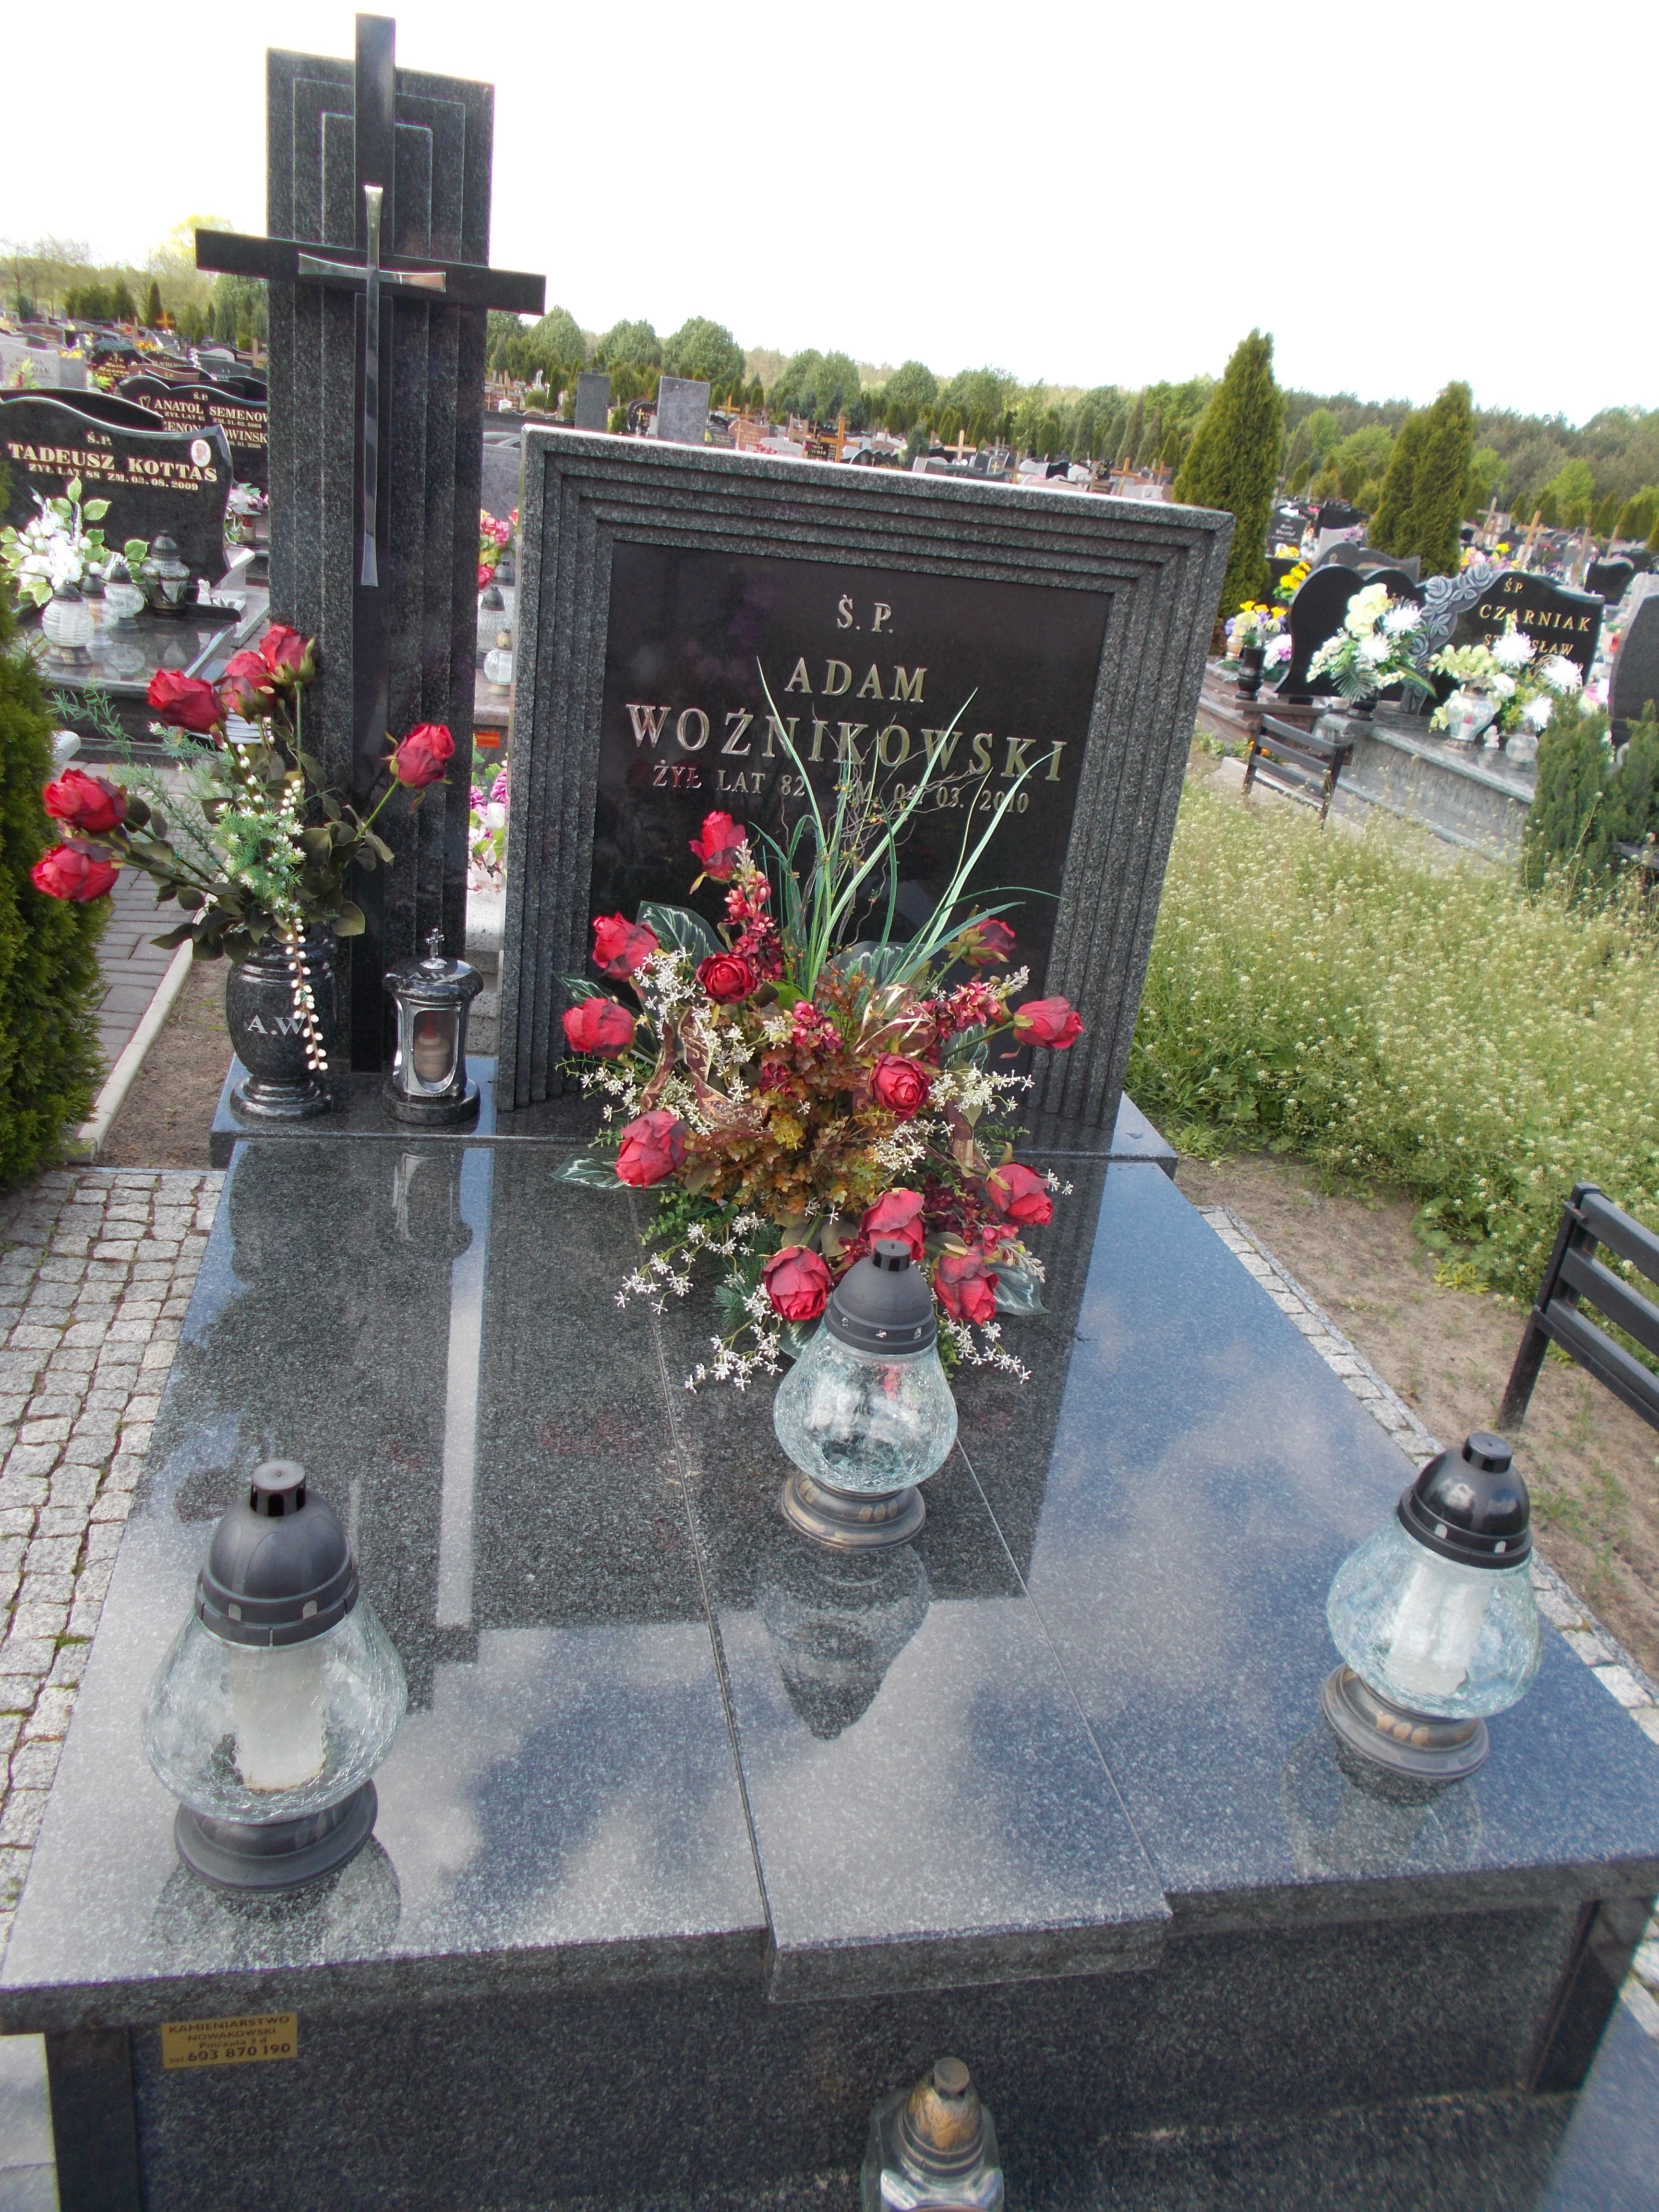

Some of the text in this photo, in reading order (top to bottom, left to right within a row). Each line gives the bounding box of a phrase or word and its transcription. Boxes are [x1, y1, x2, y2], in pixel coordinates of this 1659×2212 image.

[155, 399, 204, 414] ANATOL
[8, 444, 217, 482] TADEUSZ KOTTAS
[58, 466, 82, 477] LAT
[1480, 604, 1592, 632] CZARNIAK
[1484, 634, 1574, 655] SSŁAW
[784, 657, 927, 703] ADAM
[625, 704, 1067, 781] WOŹNIKOWSKI
[653, 760, 702, 788] ŻYŁ
[716, 770, 766, 794] LAT
[781, 775, 806, 797] 82
[169, 2016, 290, 2033] KAMIENIARSTWO
[188, 2027, 276, 2041] NOWAKOWSKI
[188, 2049, 218, 2061] 603
[226, 2045, 257, 2058] 870
[264, 2043, 291, 2055] 190
